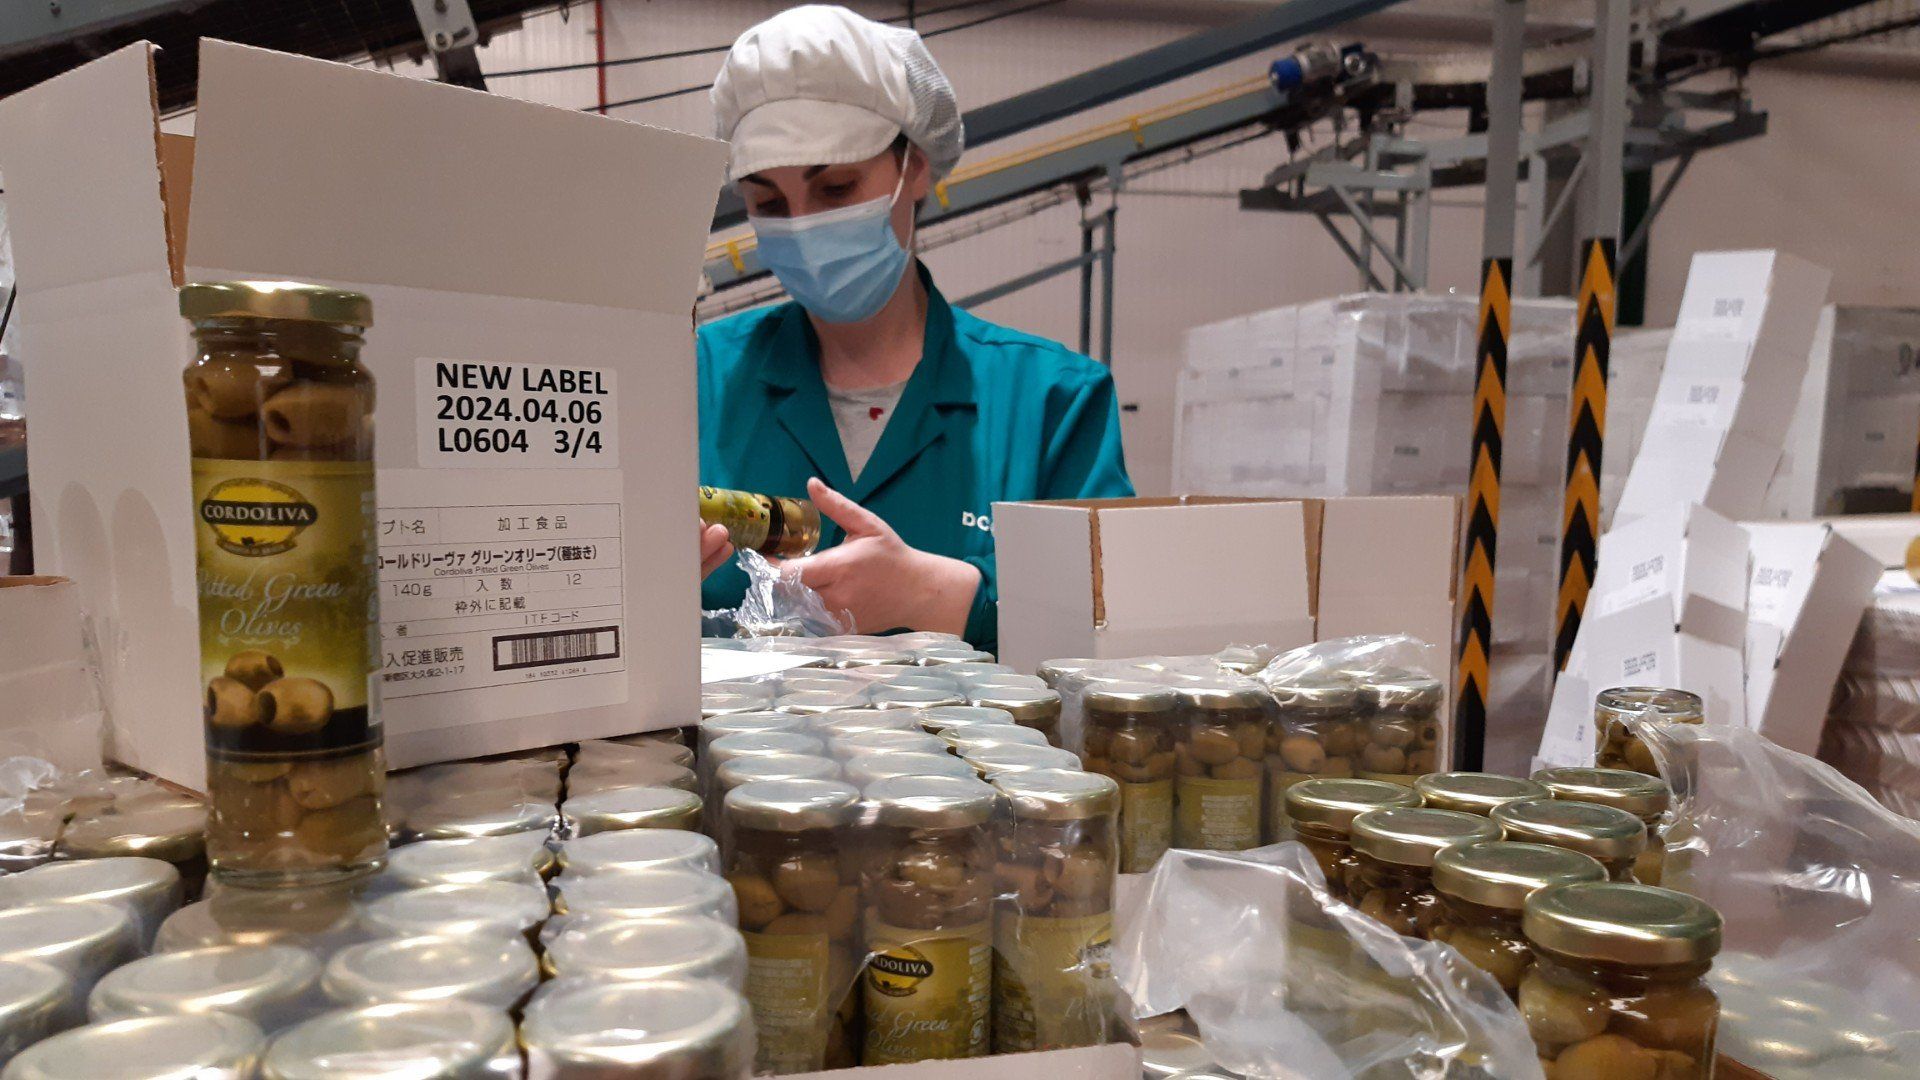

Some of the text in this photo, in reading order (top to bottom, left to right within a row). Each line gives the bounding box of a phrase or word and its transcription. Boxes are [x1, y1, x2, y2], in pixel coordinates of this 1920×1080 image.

[436, 362, 608, 394] NEW LABEL
[436, 395, 602, 424] 2024.04.06
[438, 427, 602, 458] L0604 3/4
[204, 504, 310, 521] CORDOLIVA
[961, 510, 992, 532] DC
[377, 519, 426, 535] プト名
[497, 515, 568, 531] 加工食品
[433, 567, 473, 577] Cordoliva
[500, 564, 524, 573] Green
[565, 573, 582, 586] 12
[265, 572, 344, 613] Green
[475, 577, 513, 592] 入数
[454, 596, 526, 614] 枠外に記載
[220, 600, 301, 636] Olives
[890, 1010, 949, 1038] Green
